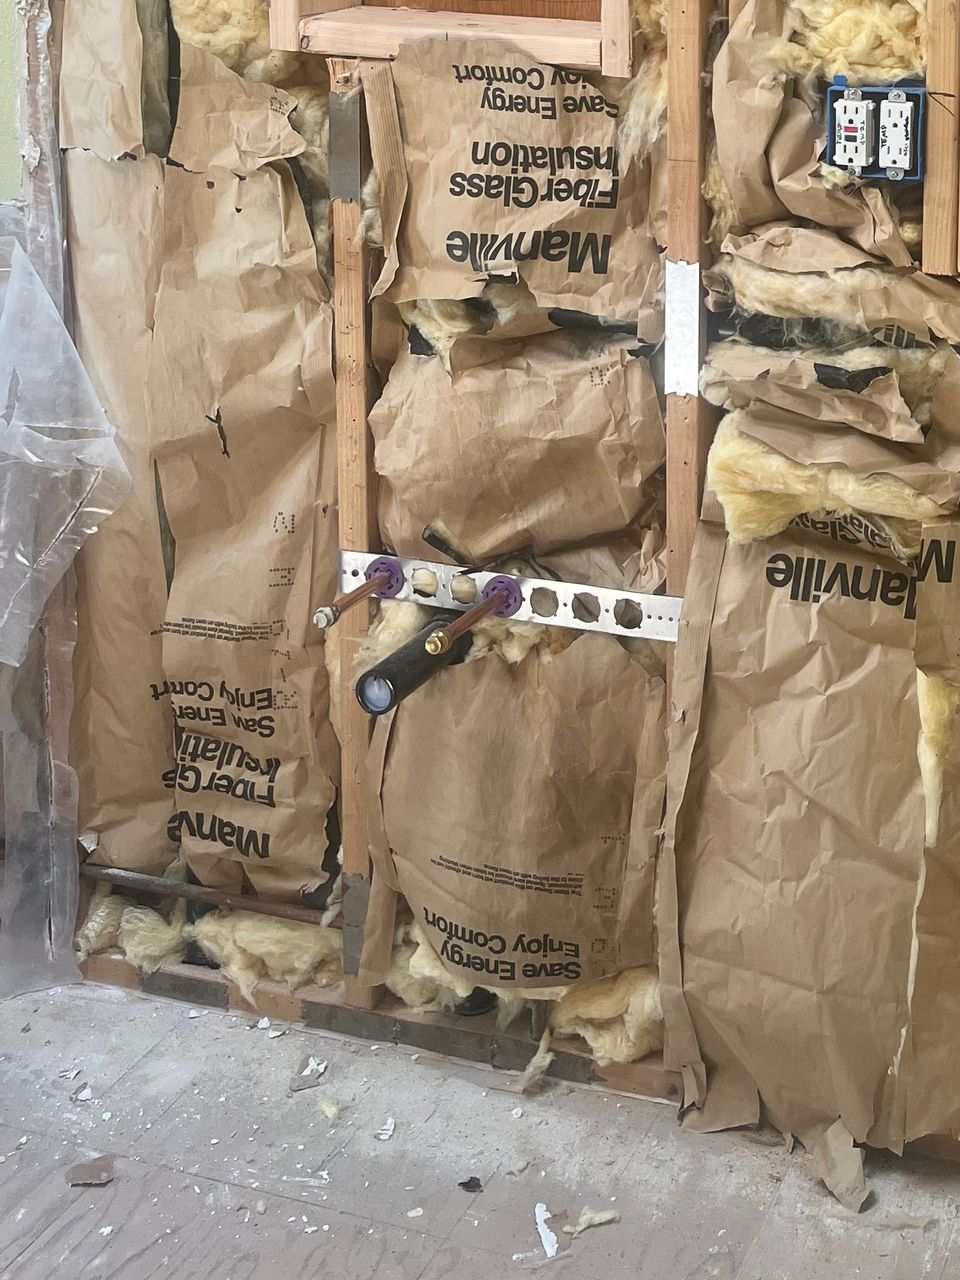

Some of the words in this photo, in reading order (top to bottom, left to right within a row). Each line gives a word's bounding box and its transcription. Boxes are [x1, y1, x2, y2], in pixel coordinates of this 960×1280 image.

[452, 64, 544, 90] Comfort
[481, 87, 557, 120] Energy
[563, 94, 619, 119] Save
[472, 141, 618, 177] Insulation
[449, 172, 619, 209] FiberGlass
[446, 230, 612, 274] Manville
[424, 906, 507, 954] Comfort
[512, 934, 580, 959] Enjoy
[440, 937, 517, 982] Energy
[522, 960, 582, 981] Save
